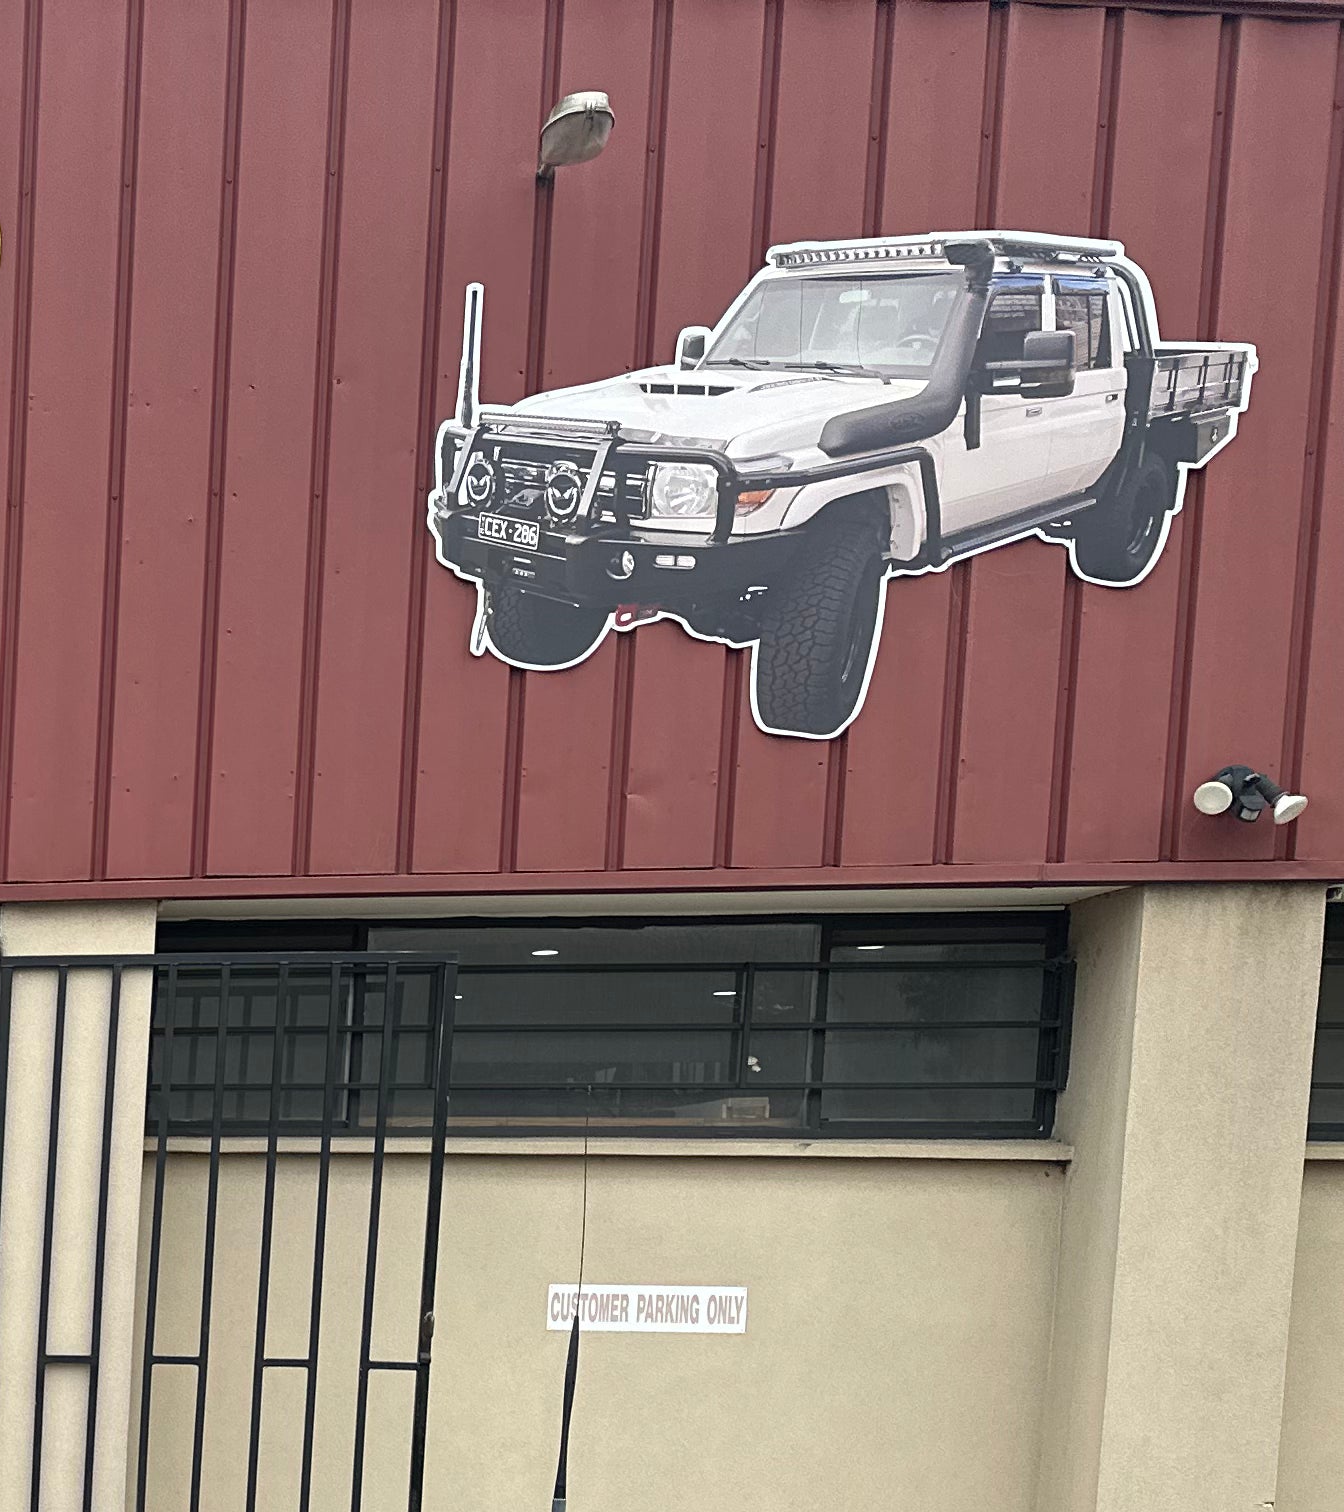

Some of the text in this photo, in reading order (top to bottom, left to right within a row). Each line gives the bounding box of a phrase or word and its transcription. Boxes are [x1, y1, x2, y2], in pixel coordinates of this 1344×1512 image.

[550, 1292, 745, 1325] CUSTOMER PARKING ONLY
